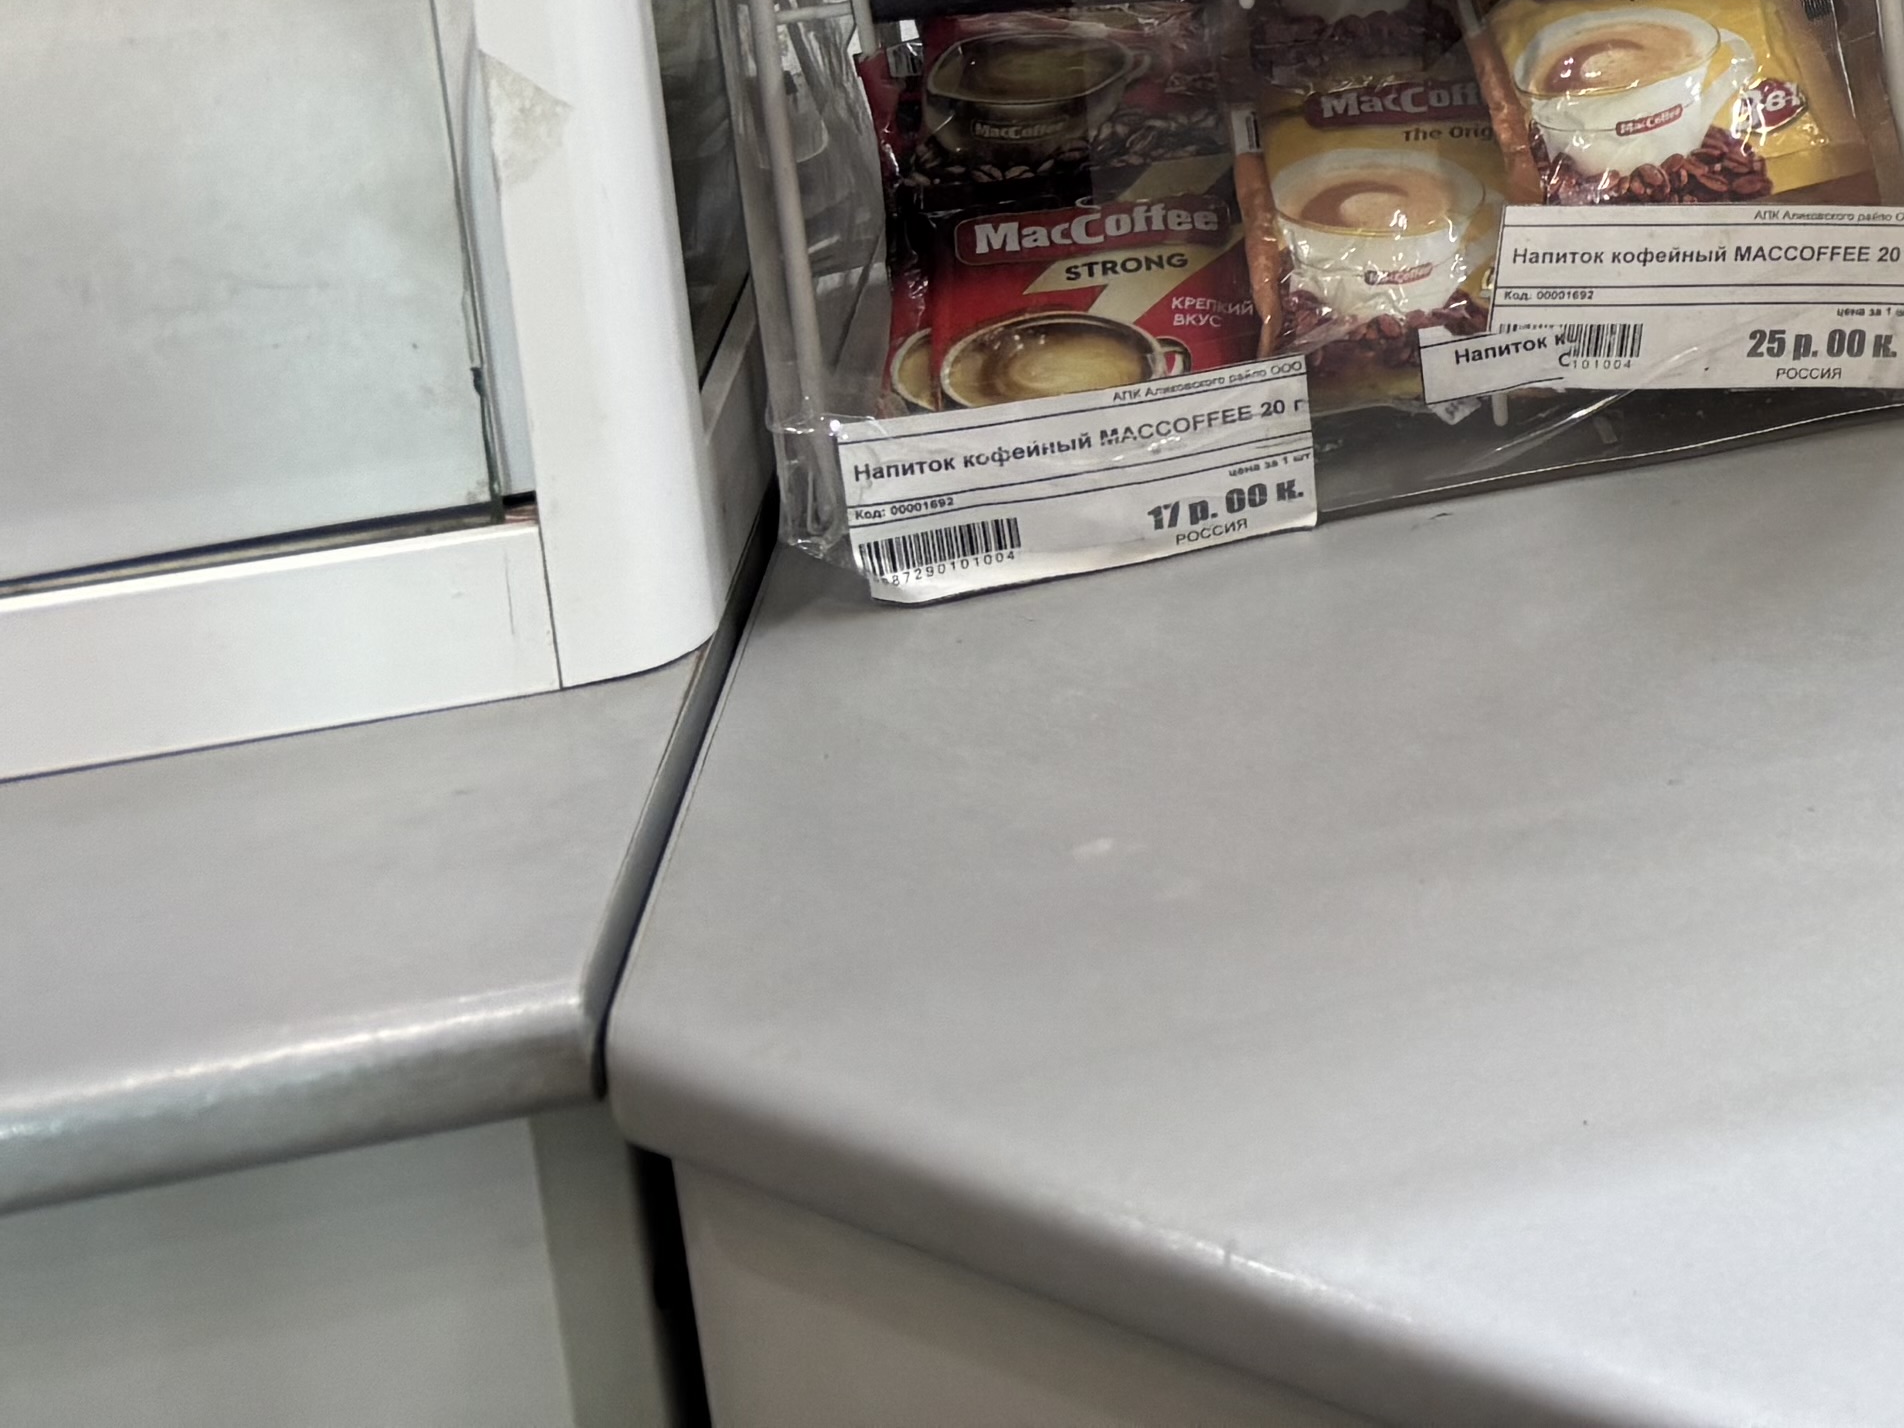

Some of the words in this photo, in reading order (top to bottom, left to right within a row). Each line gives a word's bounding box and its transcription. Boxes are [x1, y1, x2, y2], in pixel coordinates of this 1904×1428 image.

[1403, 127, 1437, 142] The
[1753, 210, 1780, 221] АПК
[974, 202, 1219, 255] MacCoffee
[1065, 252, 1189, 282] STRONG
[1512, 247, 1604, 265] Напиток
[1611, 246, 1727, 267] кофейный
[1734, 245, 1871, 263] MACCOFFEE
[1877, 246, 1901, 263] 20
[1171, 296, 1254, 316] КРЕПКИЙ
[1837, 307, 1865, 318] цена
[1172, 313, 1223, 328] ВКУС
[1454, 336, 1548, 365] Напиток
[1746, 329, 1787, 359] 25
[1792, 332, 1819, 361] р.
[1825, 328, 1867, 359] 00
[1872, 333, 1898, 358] к.
[1112, 389, 1142, 402] АПК
[1270, 360, 1302, 375] ООО
[1776, 367, 1842, 380] РОССИЯ
[853, 456, 956, 482] Напиток
[962, 431, 1092, 468] кофейный
[1099, 404, 1253, 447] MACCOFFEE
[1260, 399, 1286, 419] 20
[1228, 463, 1260, 477] цена
[855, 508, 886, 521] Код:
[1147, 500, 1180, 531] 17
[1188, 499, 1219, 526] р.
[1224, 482, 1268, 514] 00
[1275, 478, 1305, 502] к.
[1175, 517, 1249, 545] РОССИЯ
